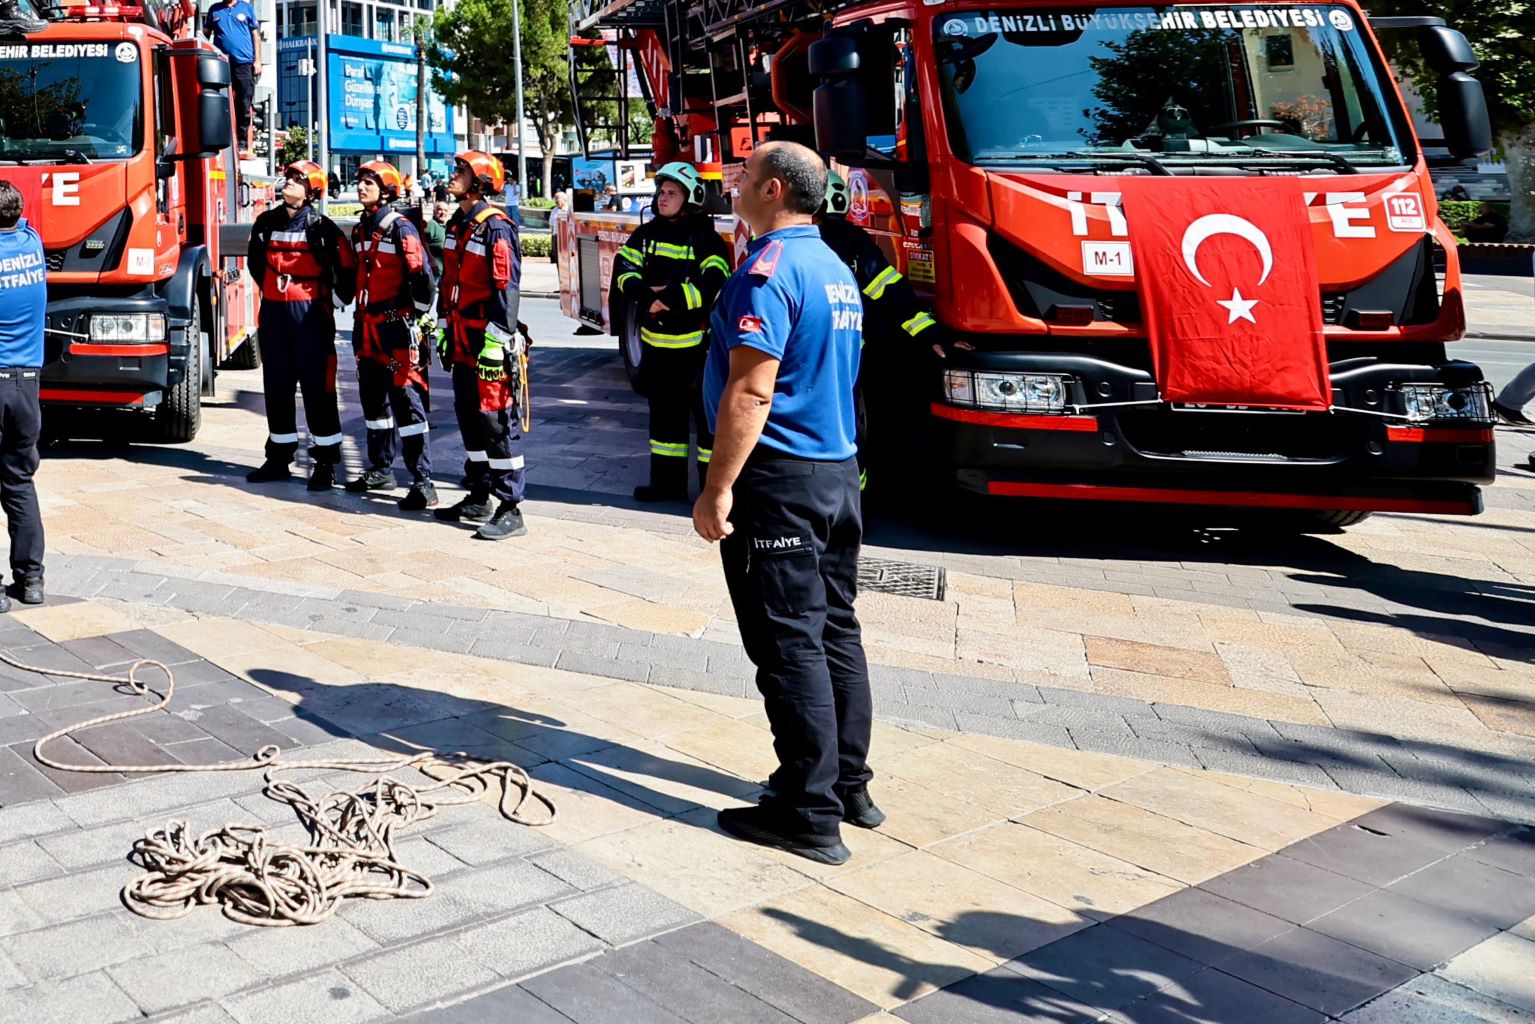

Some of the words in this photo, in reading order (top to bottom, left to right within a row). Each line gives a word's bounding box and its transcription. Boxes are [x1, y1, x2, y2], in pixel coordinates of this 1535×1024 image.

[974, 14, 1055, 33] DENİZLİ
[1202, 8, 1325, 30] BELEDİYESİ
[30, 43, 109, 58] BELEDİYESİ
[345, 64, 365, 78] Paraf
[1391, 197, 1418, 215] 112
[1094, 251, 1123, 265] M-1
[754, 536, 802, 549] İTFAİYE
